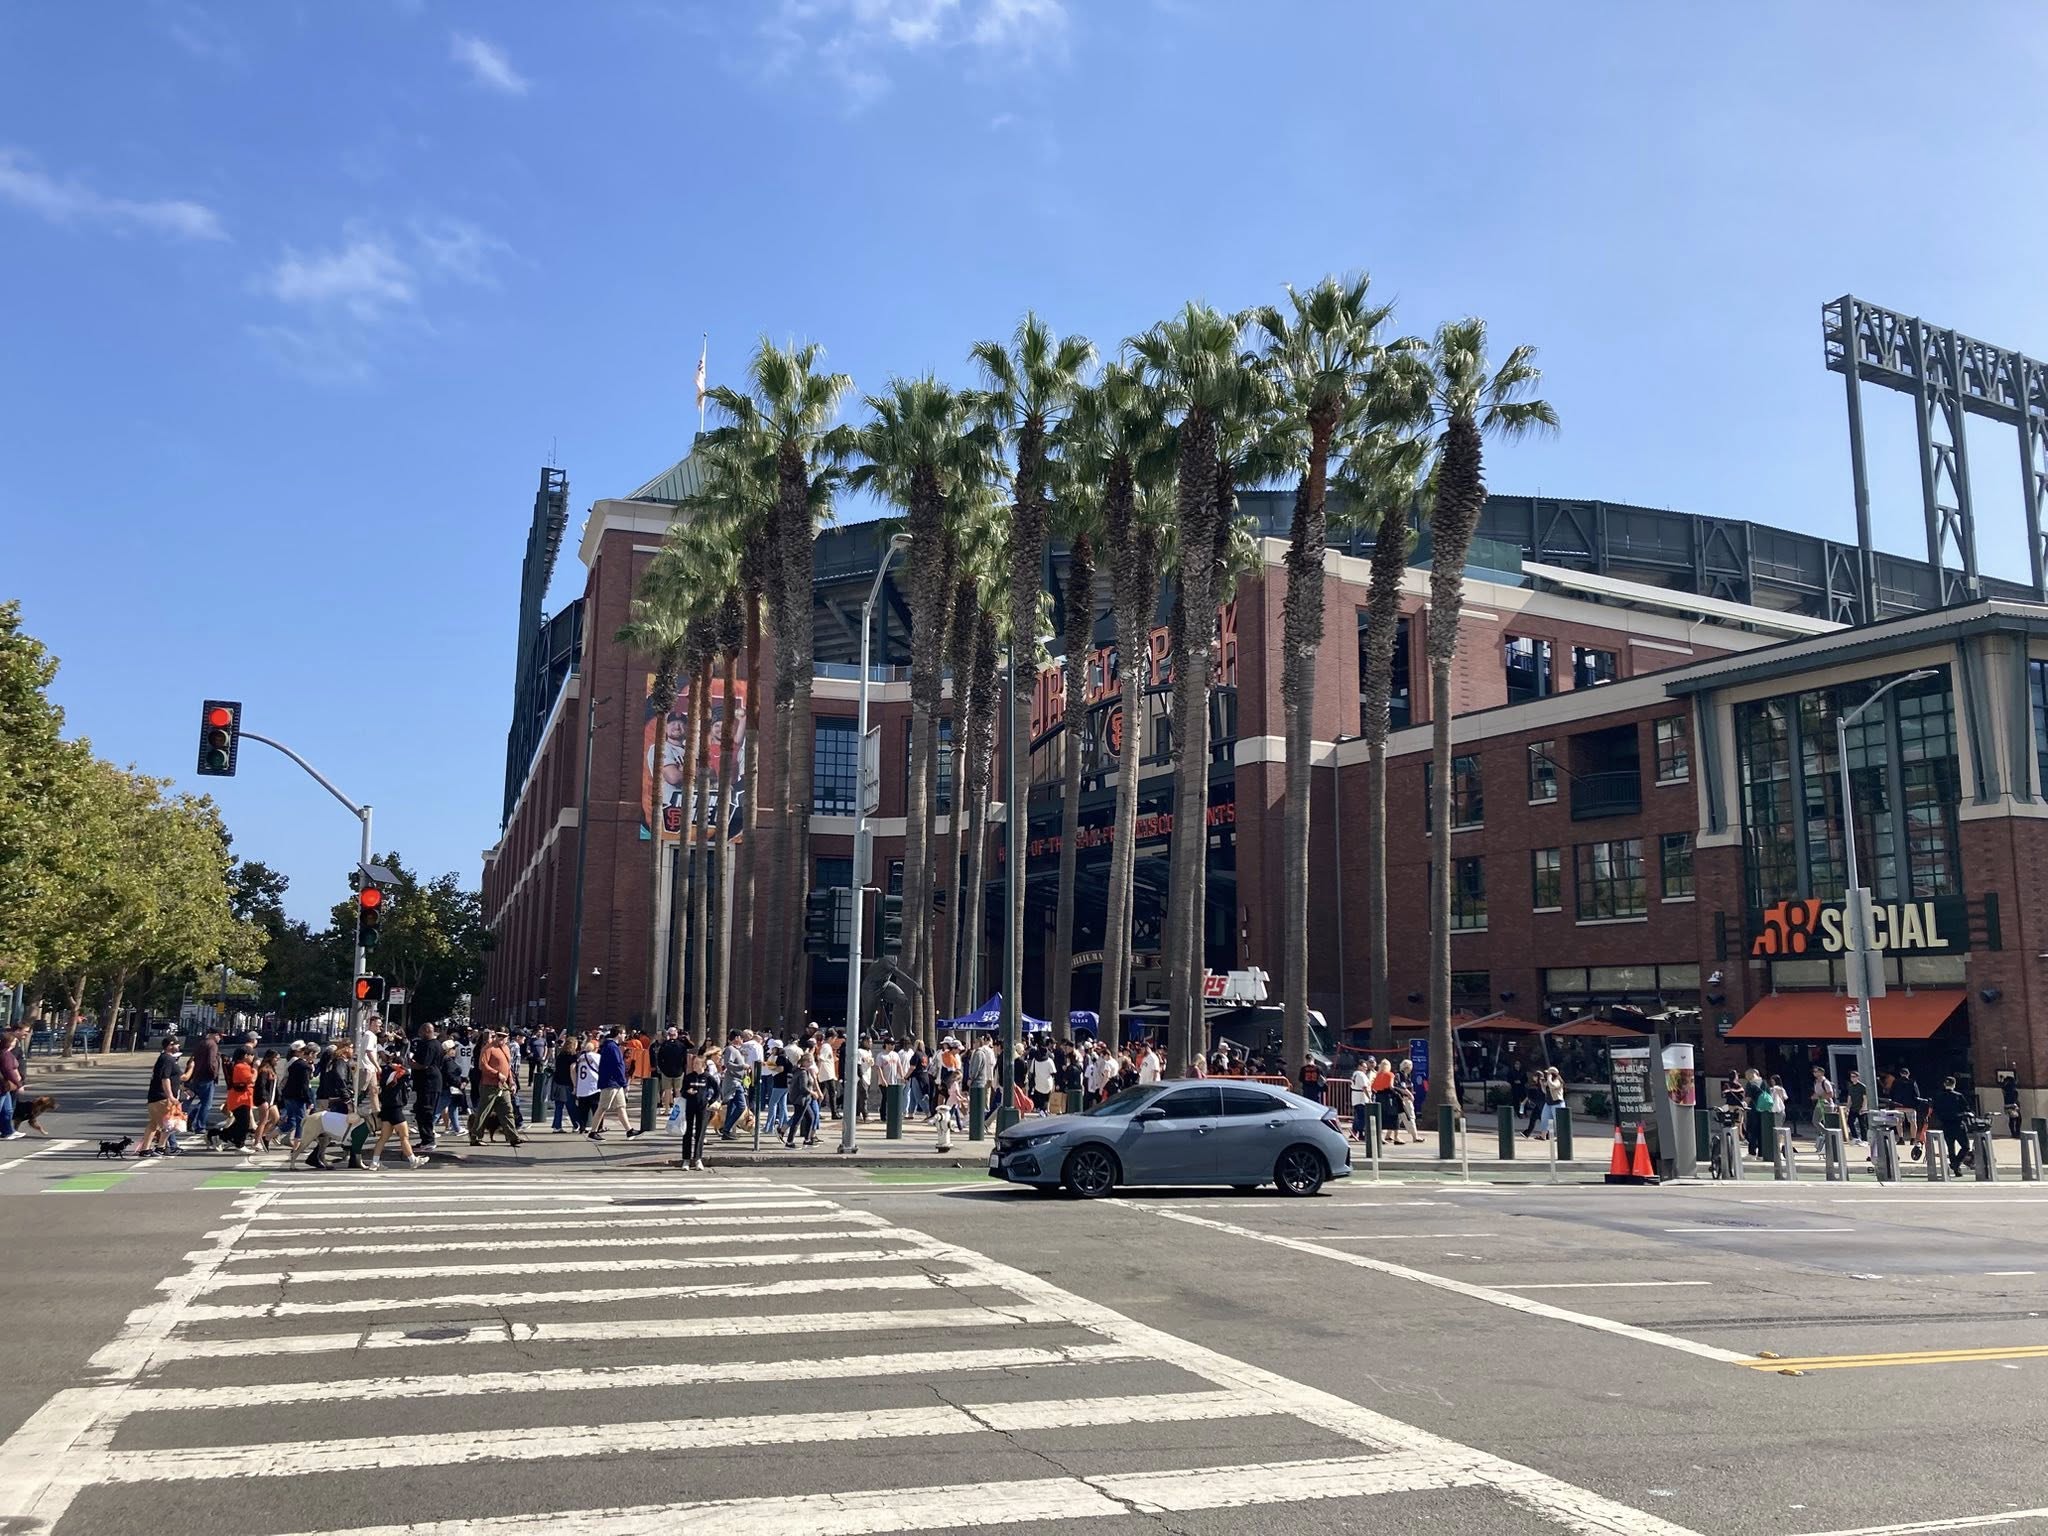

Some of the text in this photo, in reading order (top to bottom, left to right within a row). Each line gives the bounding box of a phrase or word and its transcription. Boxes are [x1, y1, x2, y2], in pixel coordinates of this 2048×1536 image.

[1030, 601, 1238, 742] ORCL PK
[1031, 839, 1045, 857] OF
[1048, 836, 1063, 853] TH
[1102, 814, 1174, 844] FRCISCO
[1206, 803, 1236, 826] NTS
[1617, 1084, 1629, 1093] This
[1626, 1105, 1634, 1113] be
